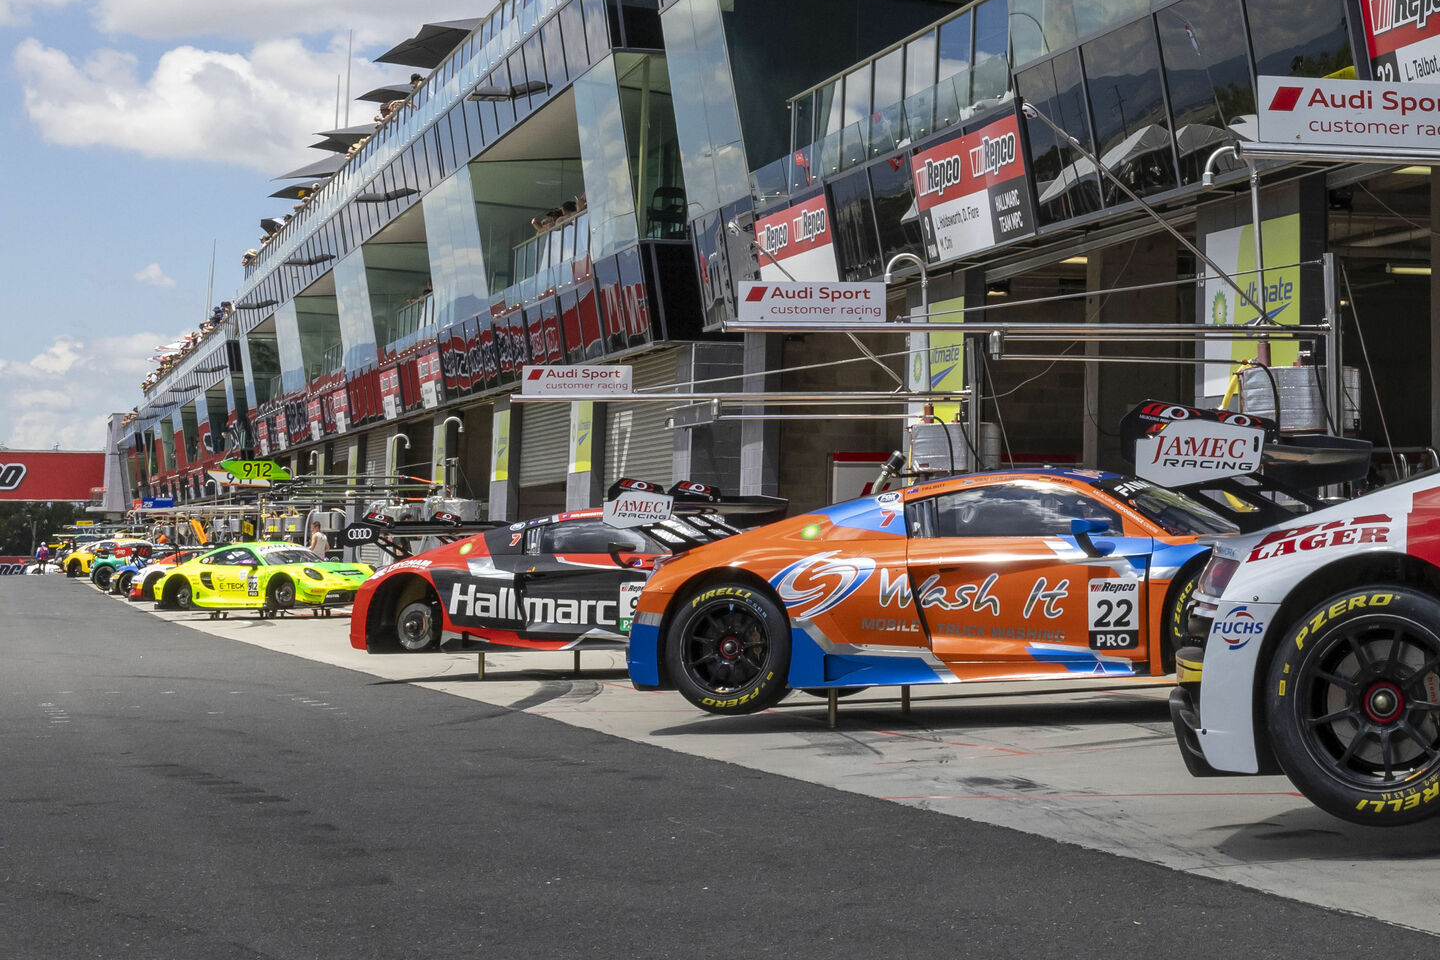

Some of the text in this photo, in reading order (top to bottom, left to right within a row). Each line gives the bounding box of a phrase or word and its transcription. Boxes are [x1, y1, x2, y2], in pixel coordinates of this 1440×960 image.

[1405, 63, 1414, 82] L.
[1413, 55, 1440, 78] Talbot,
[1307, 88, 1372, 110] Audi
[1309, 120, 1409, 135] customer
[982, 132, 1016, 176] Repco
[925, 155, 961, 196] Repco
[801, 208, 826, 243] Repco
[925, 217, 931, 239] 9
[764, 222, 789, 256] Repco
[770, 287, 871, 302] Audi Sport
[770, 305, 881, 317] customer racing
[546, 368, 621, 381] Audi Sport
[546, 382, 629, 391] customer racing
[1152, 435, 1247, 464] JAMEC
[243, 463, 272, 477] 912
[1163, 459, 1253, 471] RACING
[612, 500, 664, 516] JAMEC
[618, 512, 667, 520] RACING
[880, 510, 896, 528] 7
[1247, 527, 1391, 563] LAGER
[692, 587, 752, 608] PIRELLI
[879, 567, 1070, 619] Wash It
[1101, 582, 1136, 592] Repco
[449, 583, 617, 626] Hallmarc
[1094, 599, 1133, 628] 22
[861, 618, 1065, 642] MOBILE TRUCK WASHING
[1213, 622, 1264, 634] FUCHS
[1096, 634, 1131, 647] PRO
